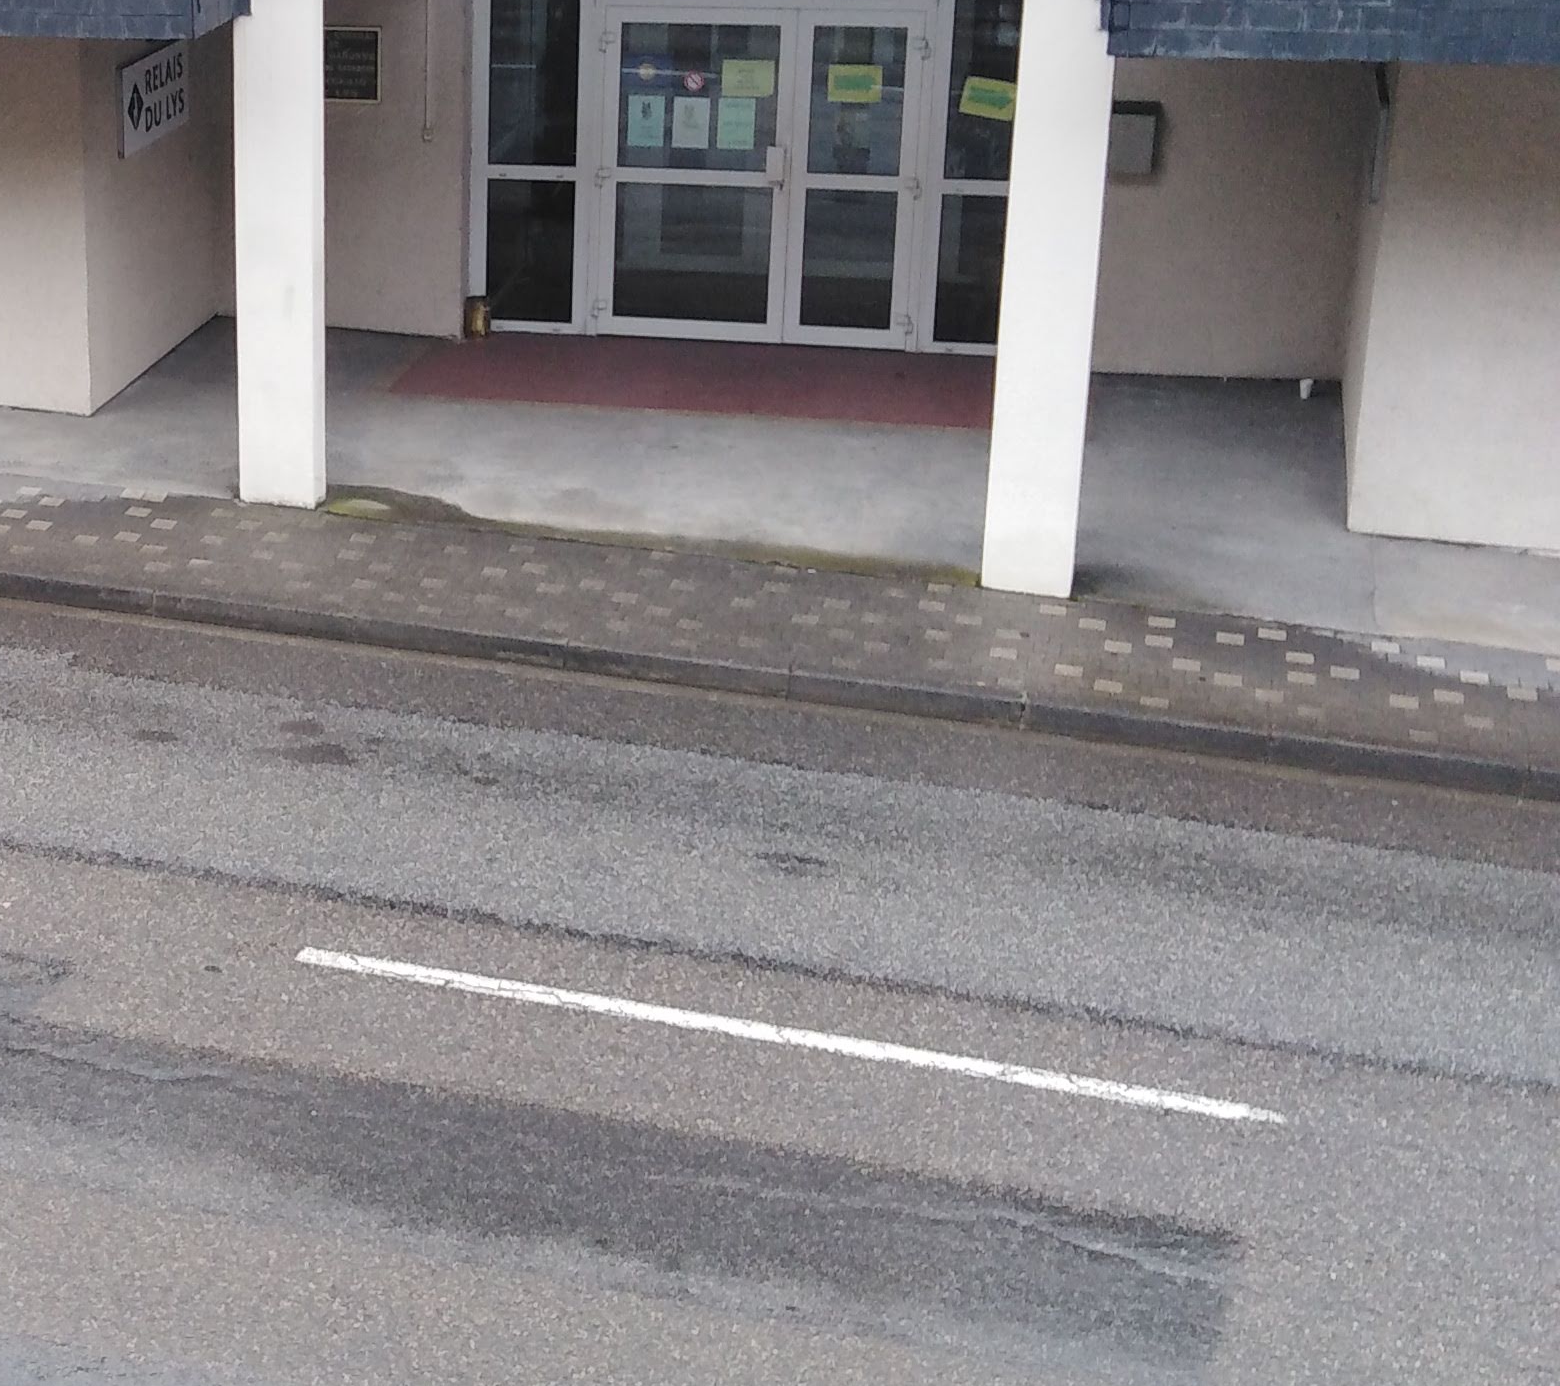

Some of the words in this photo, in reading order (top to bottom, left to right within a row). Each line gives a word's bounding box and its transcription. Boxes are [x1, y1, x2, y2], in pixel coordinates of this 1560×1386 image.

[145, 53, 183, 94] RELAIS
[145, 101, 161, 132] DU
[166, 88, 184, 120] LYS
